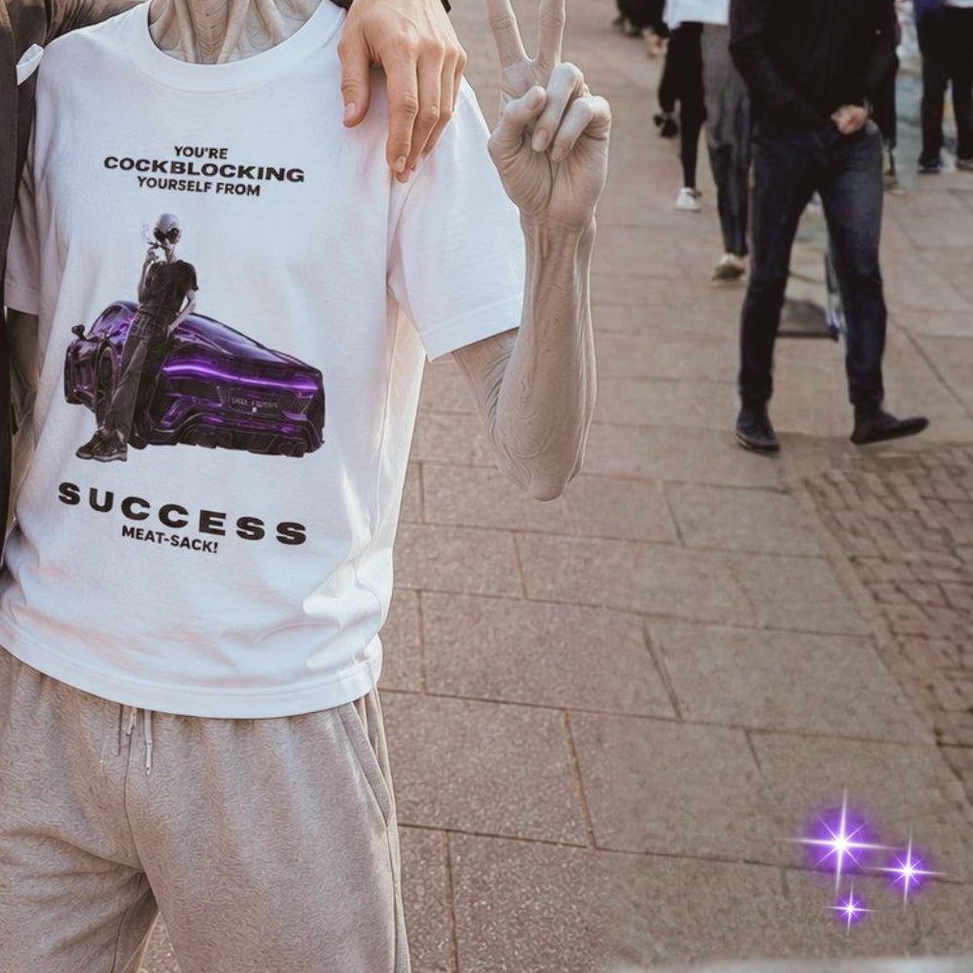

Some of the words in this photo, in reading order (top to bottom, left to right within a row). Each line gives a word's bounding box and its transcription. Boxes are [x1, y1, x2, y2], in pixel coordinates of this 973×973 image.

[174, 145, 229, 160] YOU'RE
[103, 156, 306, 183] COCKBLOCKING
[137, 176, 213, 194] YOURSELF
[215, 182, 262, 197] FROM
[58, 481, 308, 546] SUCCESS
[121, 525, 219, 554] MEAT-SACK!
